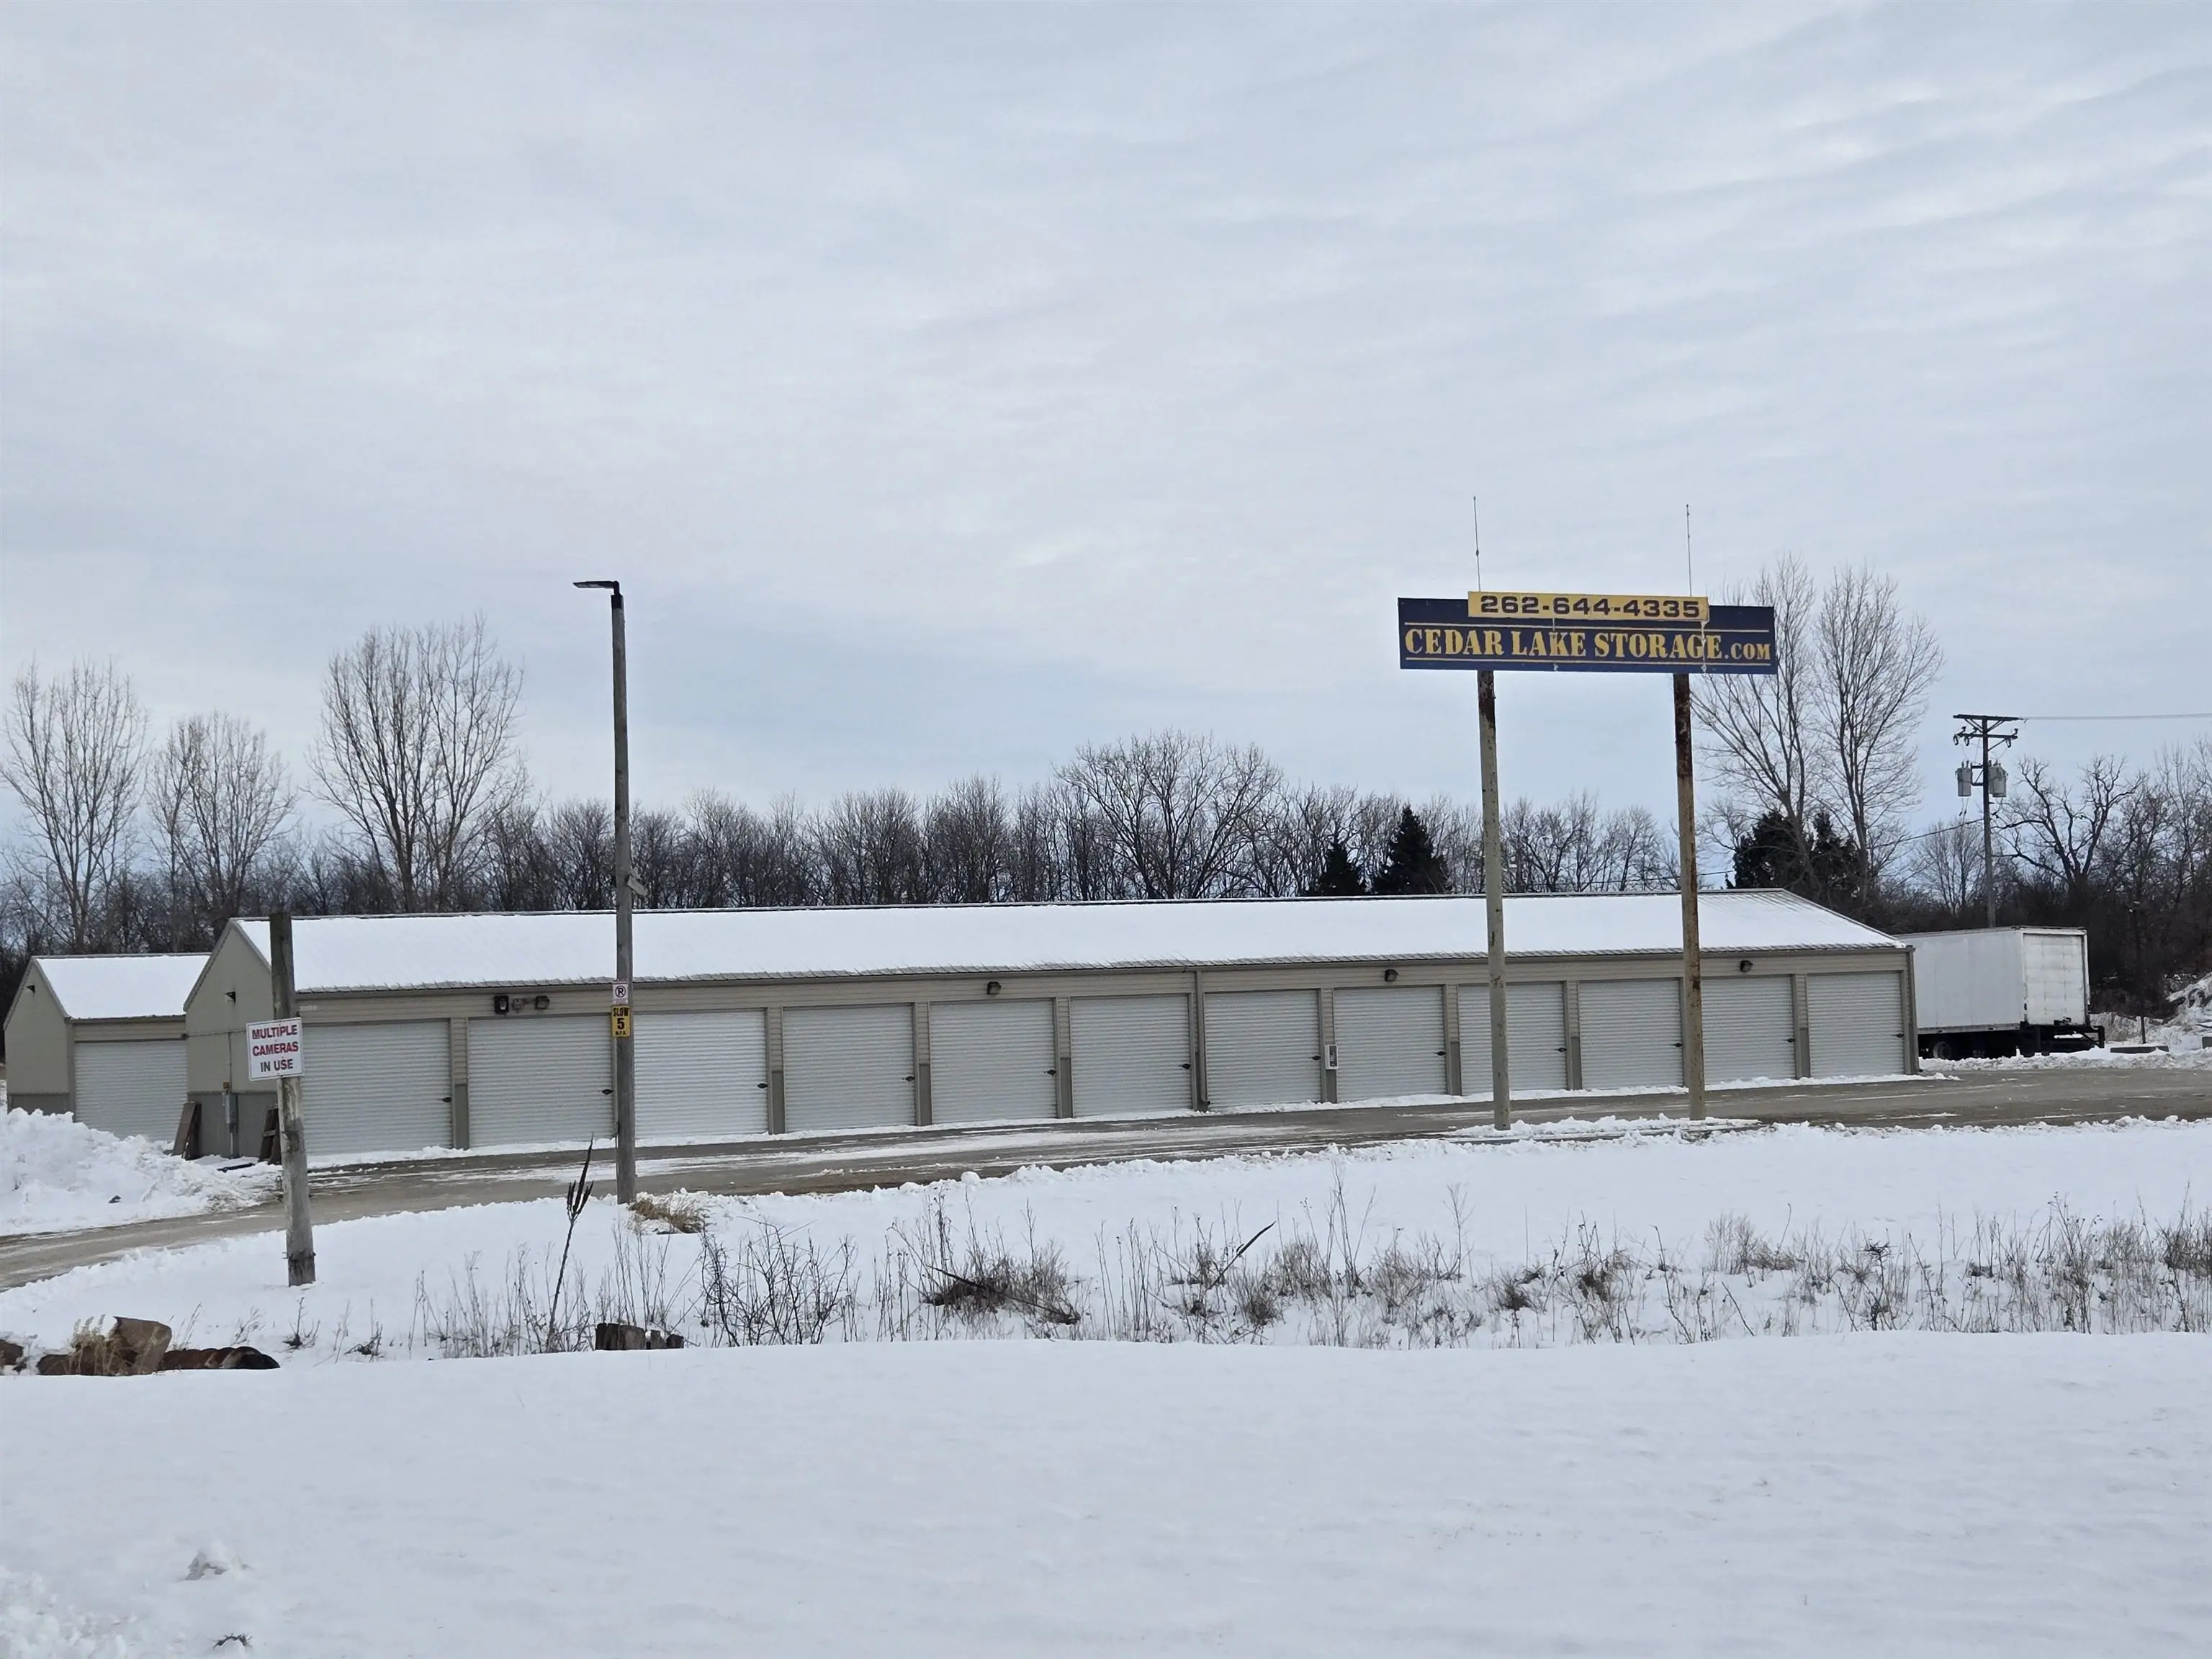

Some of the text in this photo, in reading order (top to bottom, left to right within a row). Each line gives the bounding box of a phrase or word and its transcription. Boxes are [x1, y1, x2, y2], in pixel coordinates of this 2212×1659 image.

[1480, 595, 1699, 619] 262-644-4335
[1405, 628, 1505, 656] CEDAR
[1511, 630, 1586, 657] LAKE
[617, 1017, 624, 1029] 5
[252, 1025, 297, 1040] MULTIPLE
[253, 1041, 299, 1056] CAMERAS
[260, 1058, 294, 1072] IN USE
